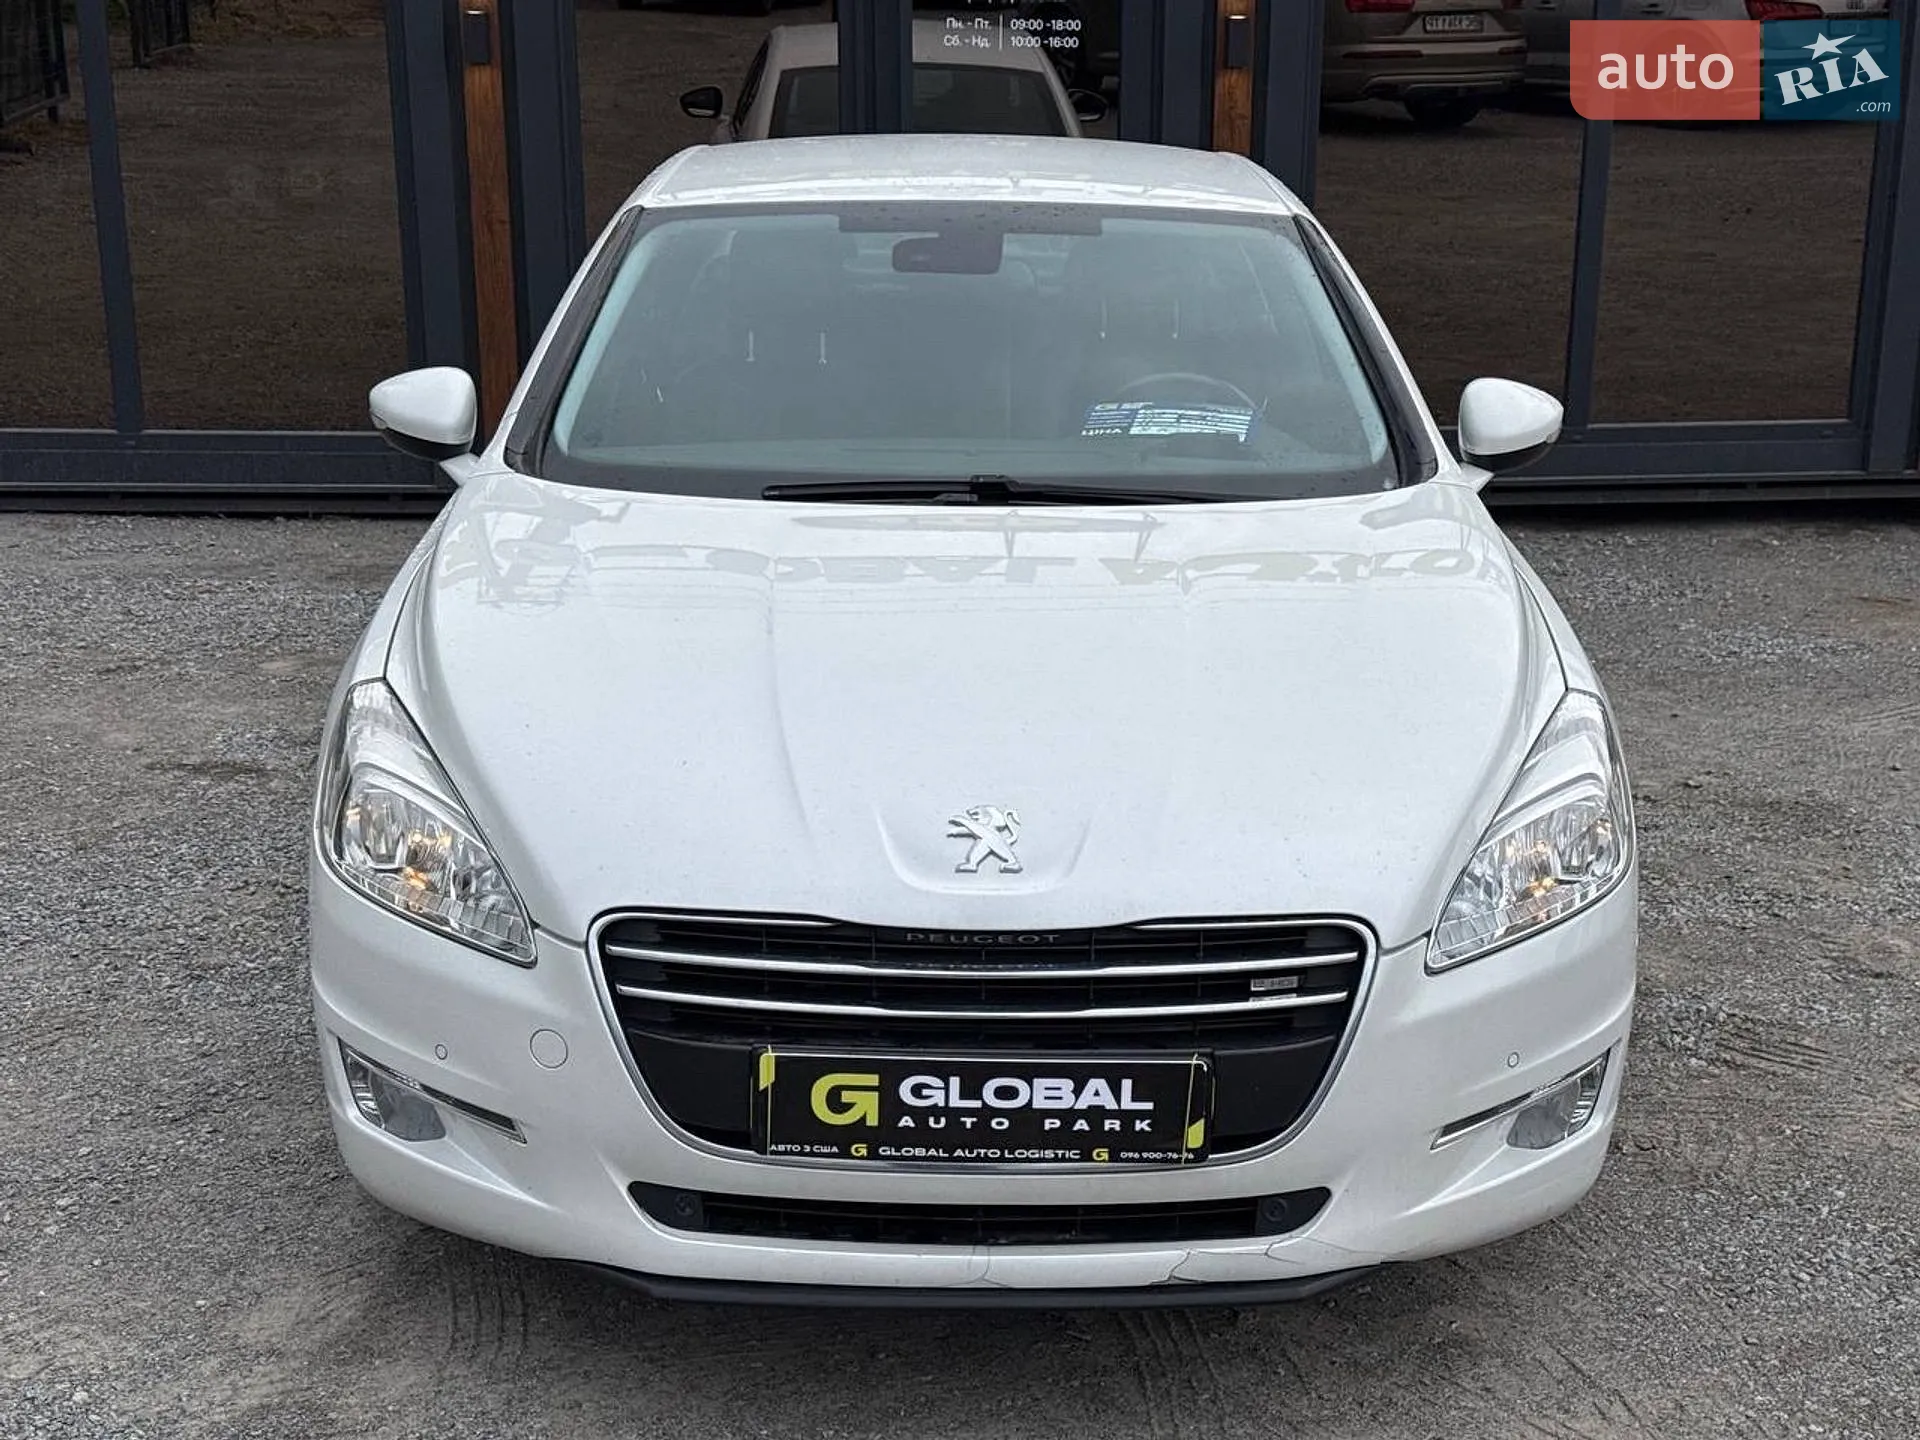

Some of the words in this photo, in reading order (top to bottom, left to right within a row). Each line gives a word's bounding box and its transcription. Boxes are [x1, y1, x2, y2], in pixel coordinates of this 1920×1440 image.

[974, 18, 992, 29] Пт.
[1010, 19, 1044, 31] 09:00
[1010, 36, 1041, 48] 10:00
[906, 932, 1060, 944] PEUGEOT
[898, 1075, 1155, 1110] GLOBAL
[897, 1115, 1010, 1130] AUTO
[1043, 1118, 1153, 1131] PARK
[770, 1143, 801, 1153] АВТО
[812, 1145, 839, 1154] США
[878, 1146, 949, 1157] GLOBAL
[952, 1148, 1001, 1158] AUTO
[1004, 1149, 1081, 1159] LOGISTIC
[1120, 1151, 1140, 1160] 096
